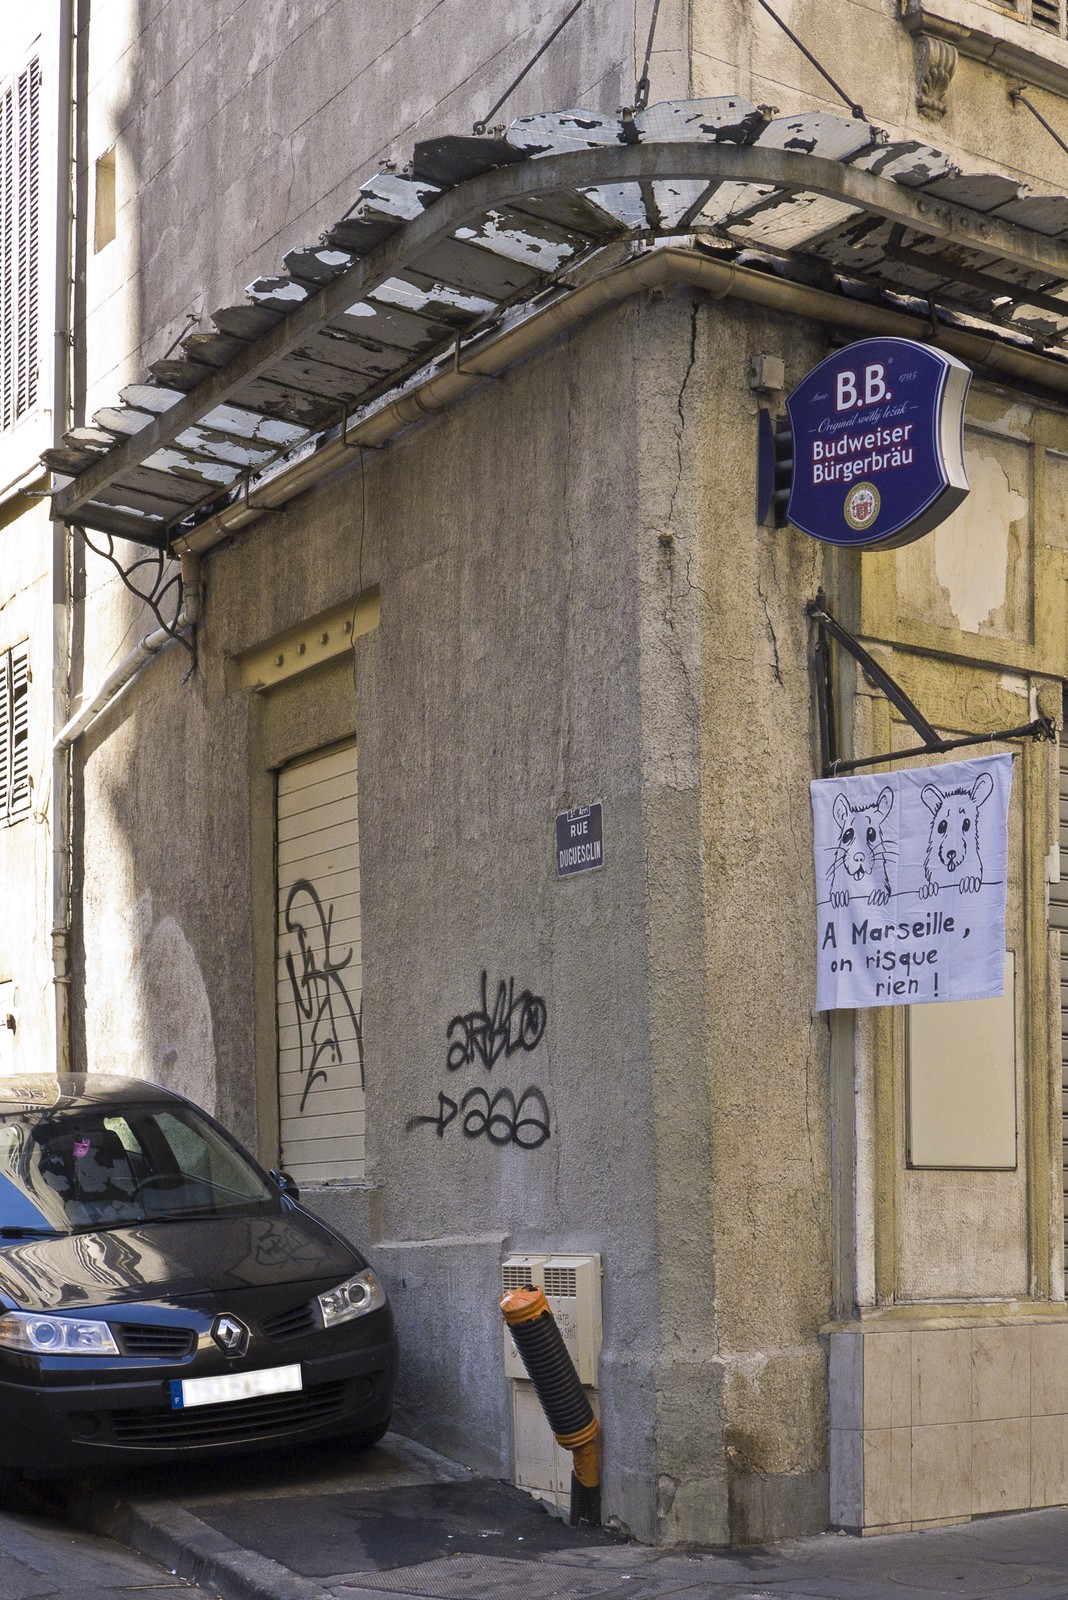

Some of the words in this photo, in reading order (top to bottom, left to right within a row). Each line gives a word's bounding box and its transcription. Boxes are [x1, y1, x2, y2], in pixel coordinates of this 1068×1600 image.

[837, 363, 891, 410] B.B.
[813, 424, 913, 460] Budweiser
[813, 446, 913, 483] Bürgerbräu
[570, 821, 588, 838] RUE
[560, 840, 601, 868] DUGUESCLIN
[822, 921, 837, 950] A
[831, 958, 853, 973] on
[866, 949, 938, 976] risque
[876, 975, 919, 997] rien
